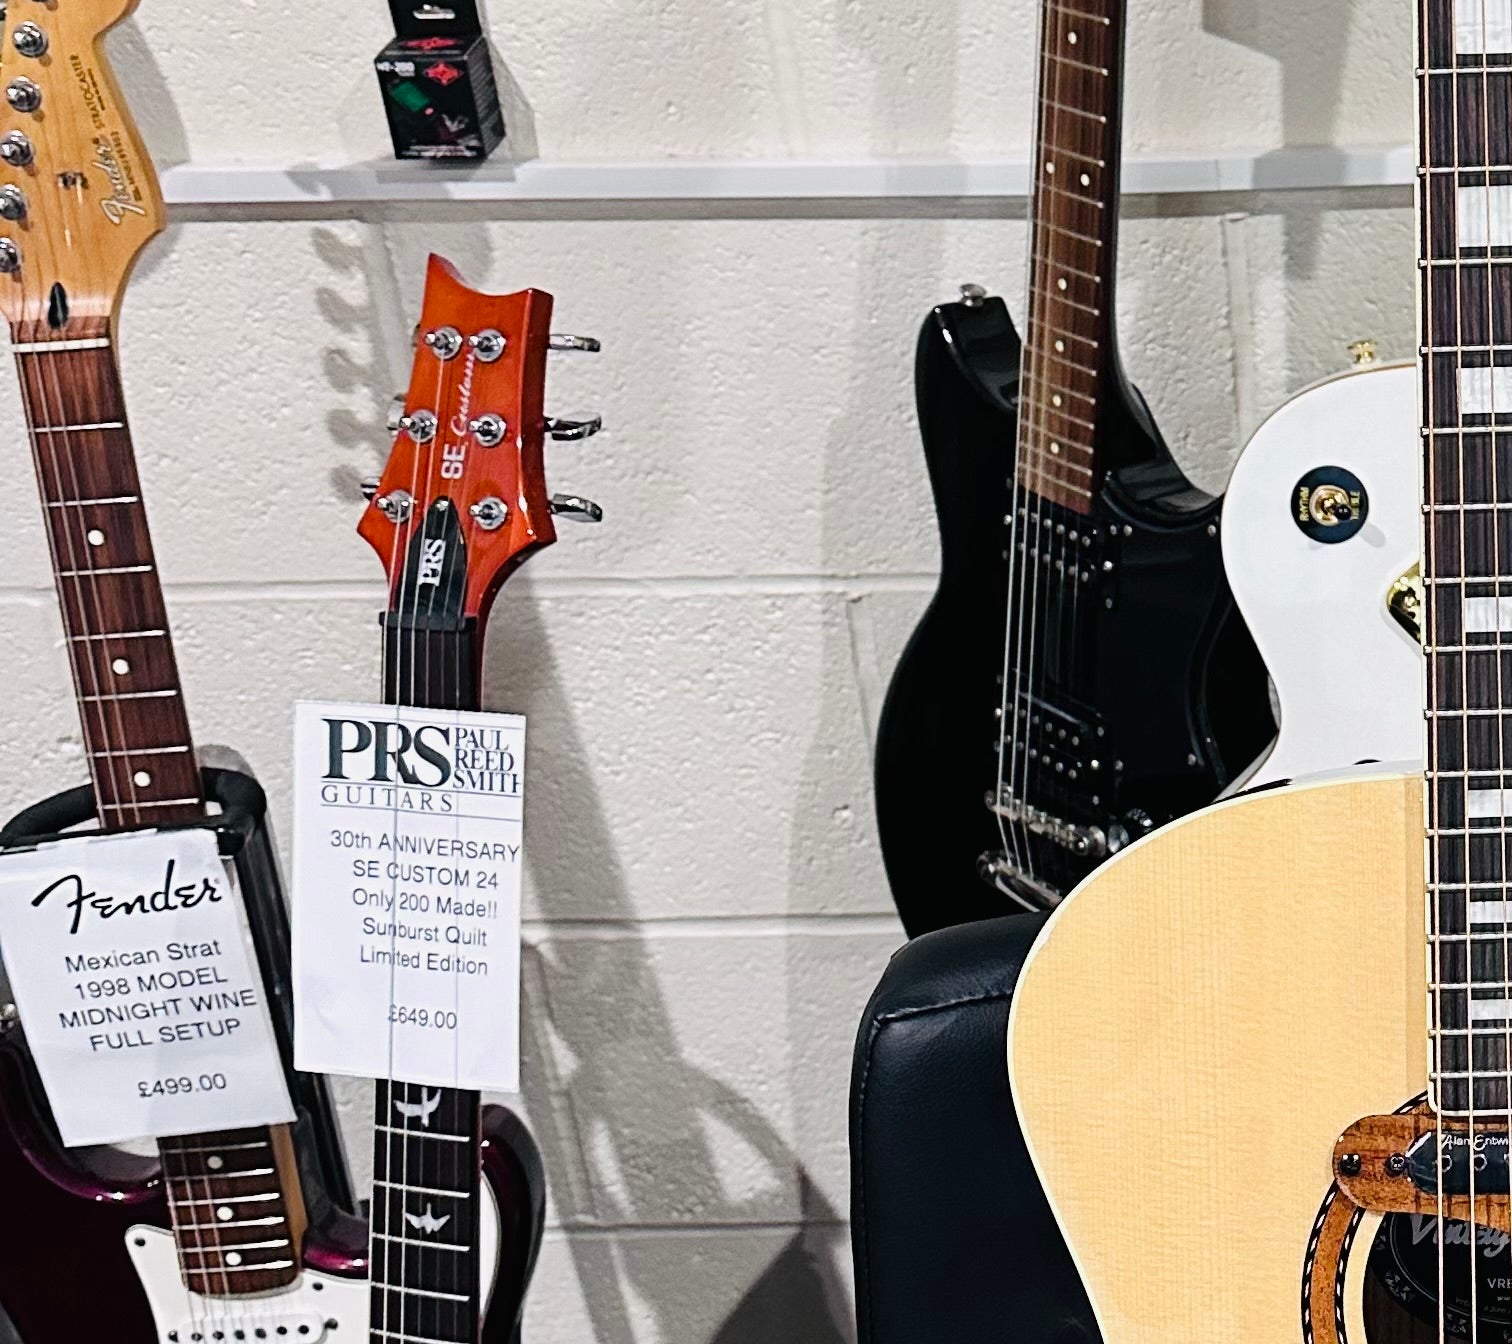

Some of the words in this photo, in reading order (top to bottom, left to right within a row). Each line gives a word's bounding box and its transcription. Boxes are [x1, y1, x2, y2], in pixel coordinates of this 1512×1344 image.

[441, 444, 466, 479] SE
[418, 538, 446, 587] PRS
[321, 718, 452, 787] PRS
[455, 727, 509, 751] PAUL
[455, 748, 514, 772] REED
[321, 784, 453, 812] GUITARS
[330, 830, 372, 849] 30th
[378, 834, 520, 863] ANNIVERSARY
[353, 860, 379, 878] SE
[387, 862, 470, 887] CUSTOM
[476, 872, 499, 889] 24
[31, 859, 222, 934] Fender
[353, 888, 394, 913] Only
[399, 893, 429, 912] 200
[437, 898, 497, 919] Made!!
[363, 918, 439, 942] Sunburst
[446, 926, 487, 947] Quilt
[65, 948, 160, 973] Mexican
[167, 940, 222, 961] Strat
[361, 946, 420, 968] Limited
[428, 951, 488, 975] Edition
[75, 980, 130, 1001] 1998
[137, 967, 228, 992] MODEL
[59, 999, 182, 1029] MIDNIGHT
[190, 989, 257, 1013] WINE
[388, 1005, 457, 1029] £649.00
[90, 1029, 153, 1051] FULL
[160, 1018, 241, 1044] SETUP
[138, 1073, 227, 1099] £499.00
